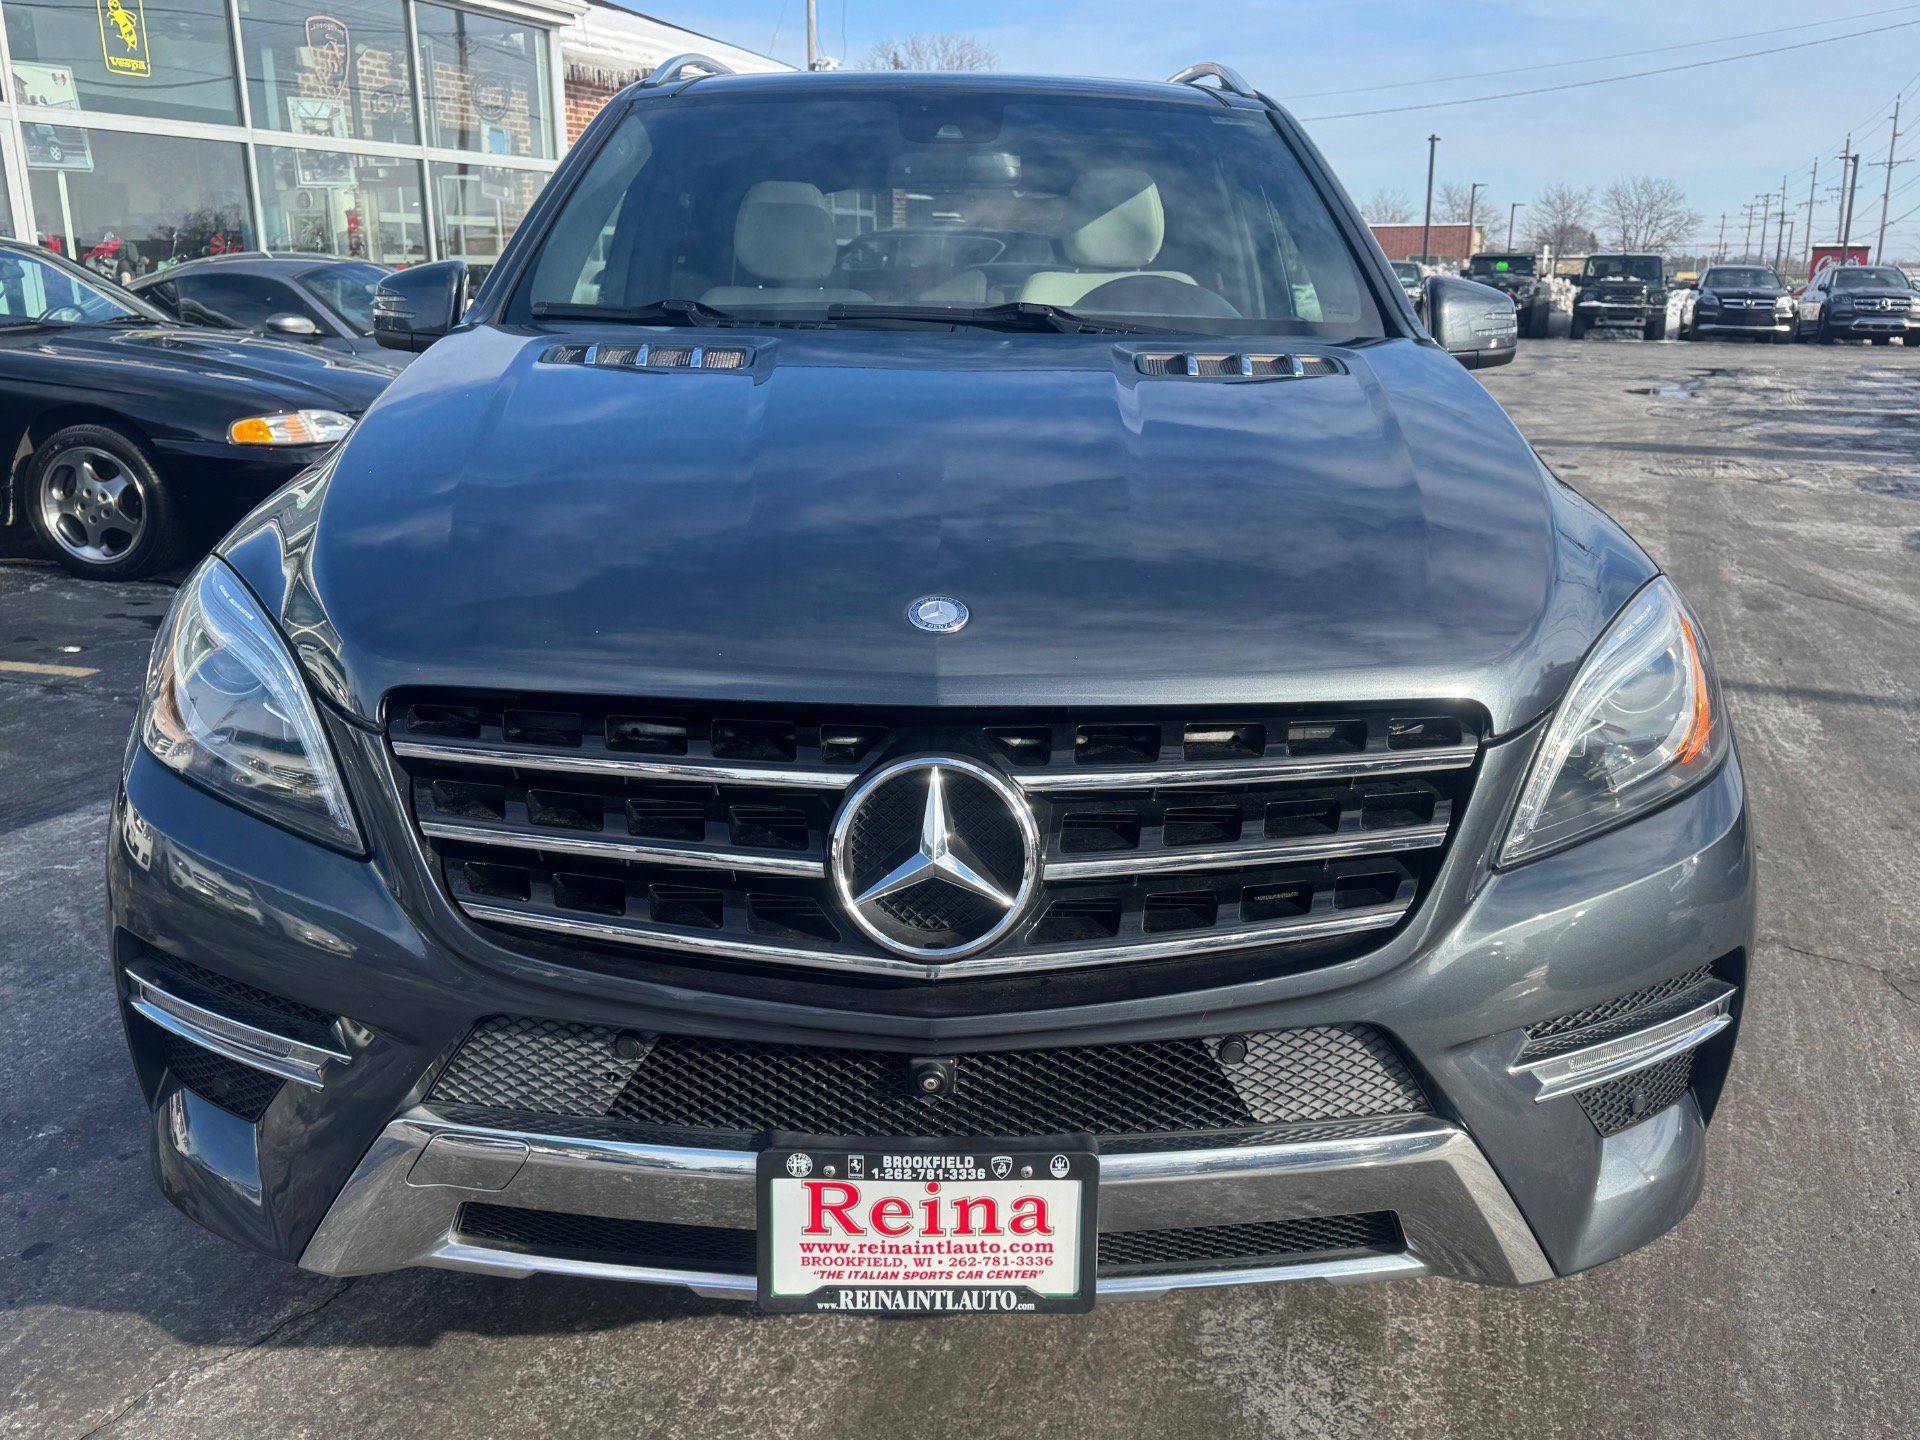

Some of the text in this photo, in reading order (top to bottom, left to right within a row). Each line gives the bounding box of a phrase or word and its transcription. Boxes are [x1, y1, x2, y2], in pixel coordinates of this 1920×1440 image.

[109, 56, 147, 71] Vespa
[883, 1155, 975, 1168] BROOKFIELD
[871, 1168, 986, 1180] 1-262-781-3336
[801, 1180, 1055, 1237] Reina
[799, 1240, 1055, 1255] www.reinaintlauto.com
[800, 1256, 1053, 1269] BROOKFIELD, WI 262-781-3336
[847, 1270, 899, 1280] ITALIAN
[902, 1270, 953, 1280] SPORTS
[957, 1270, 983, 1279] CAR
[816, 1289, 1035, 1311] www.REINAINTLAUTO.com
